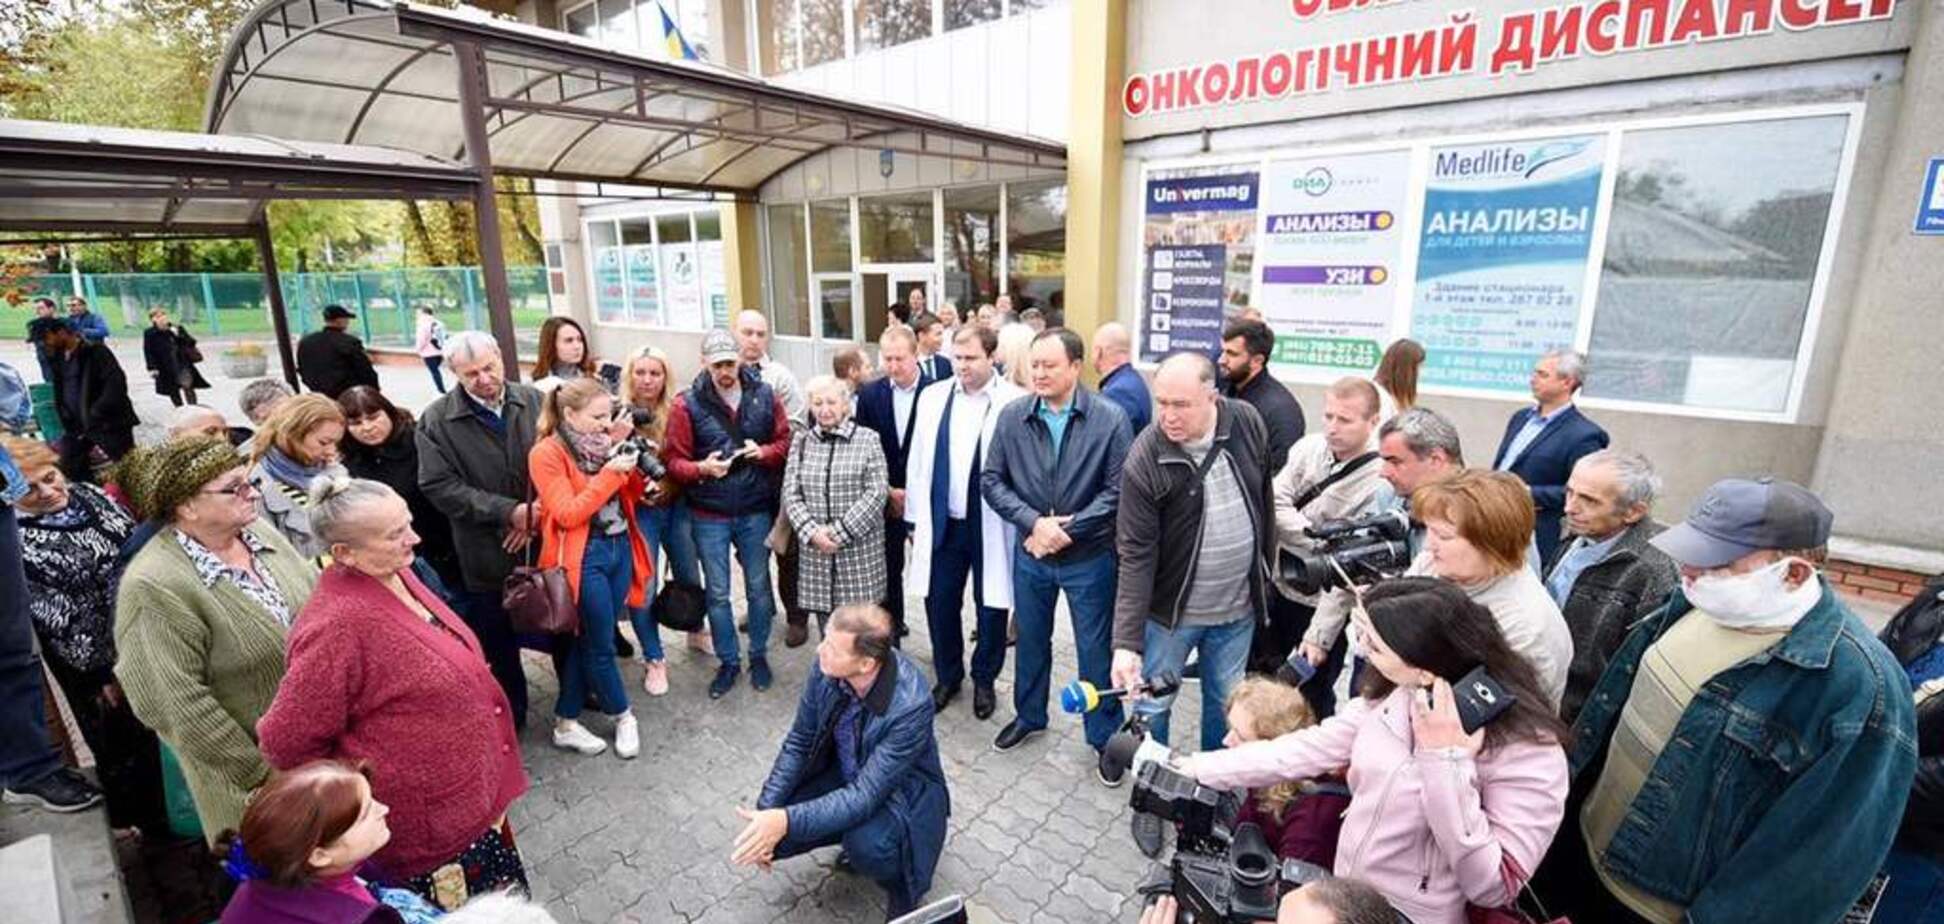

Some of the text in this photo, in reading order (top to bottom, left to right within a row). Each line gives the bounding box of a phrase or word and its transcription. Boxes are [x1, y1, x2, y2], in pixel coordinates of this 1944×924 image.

[1126, 13, 1477, 114] ОНКОЛОГІЧНИЙ
[1436, 148, 1526, 177] Medlife
[1154, 184, 1250, 202] Univermag
[1273, 213, 1371, 232] АНАЛИЗЫ
[1427, 206, 1589, 236] АНАЛИЗЫ
[1453, 234, 1494, 247] ДЕТЕЙ
[1325, 267, 1365, 284] УЗИ
